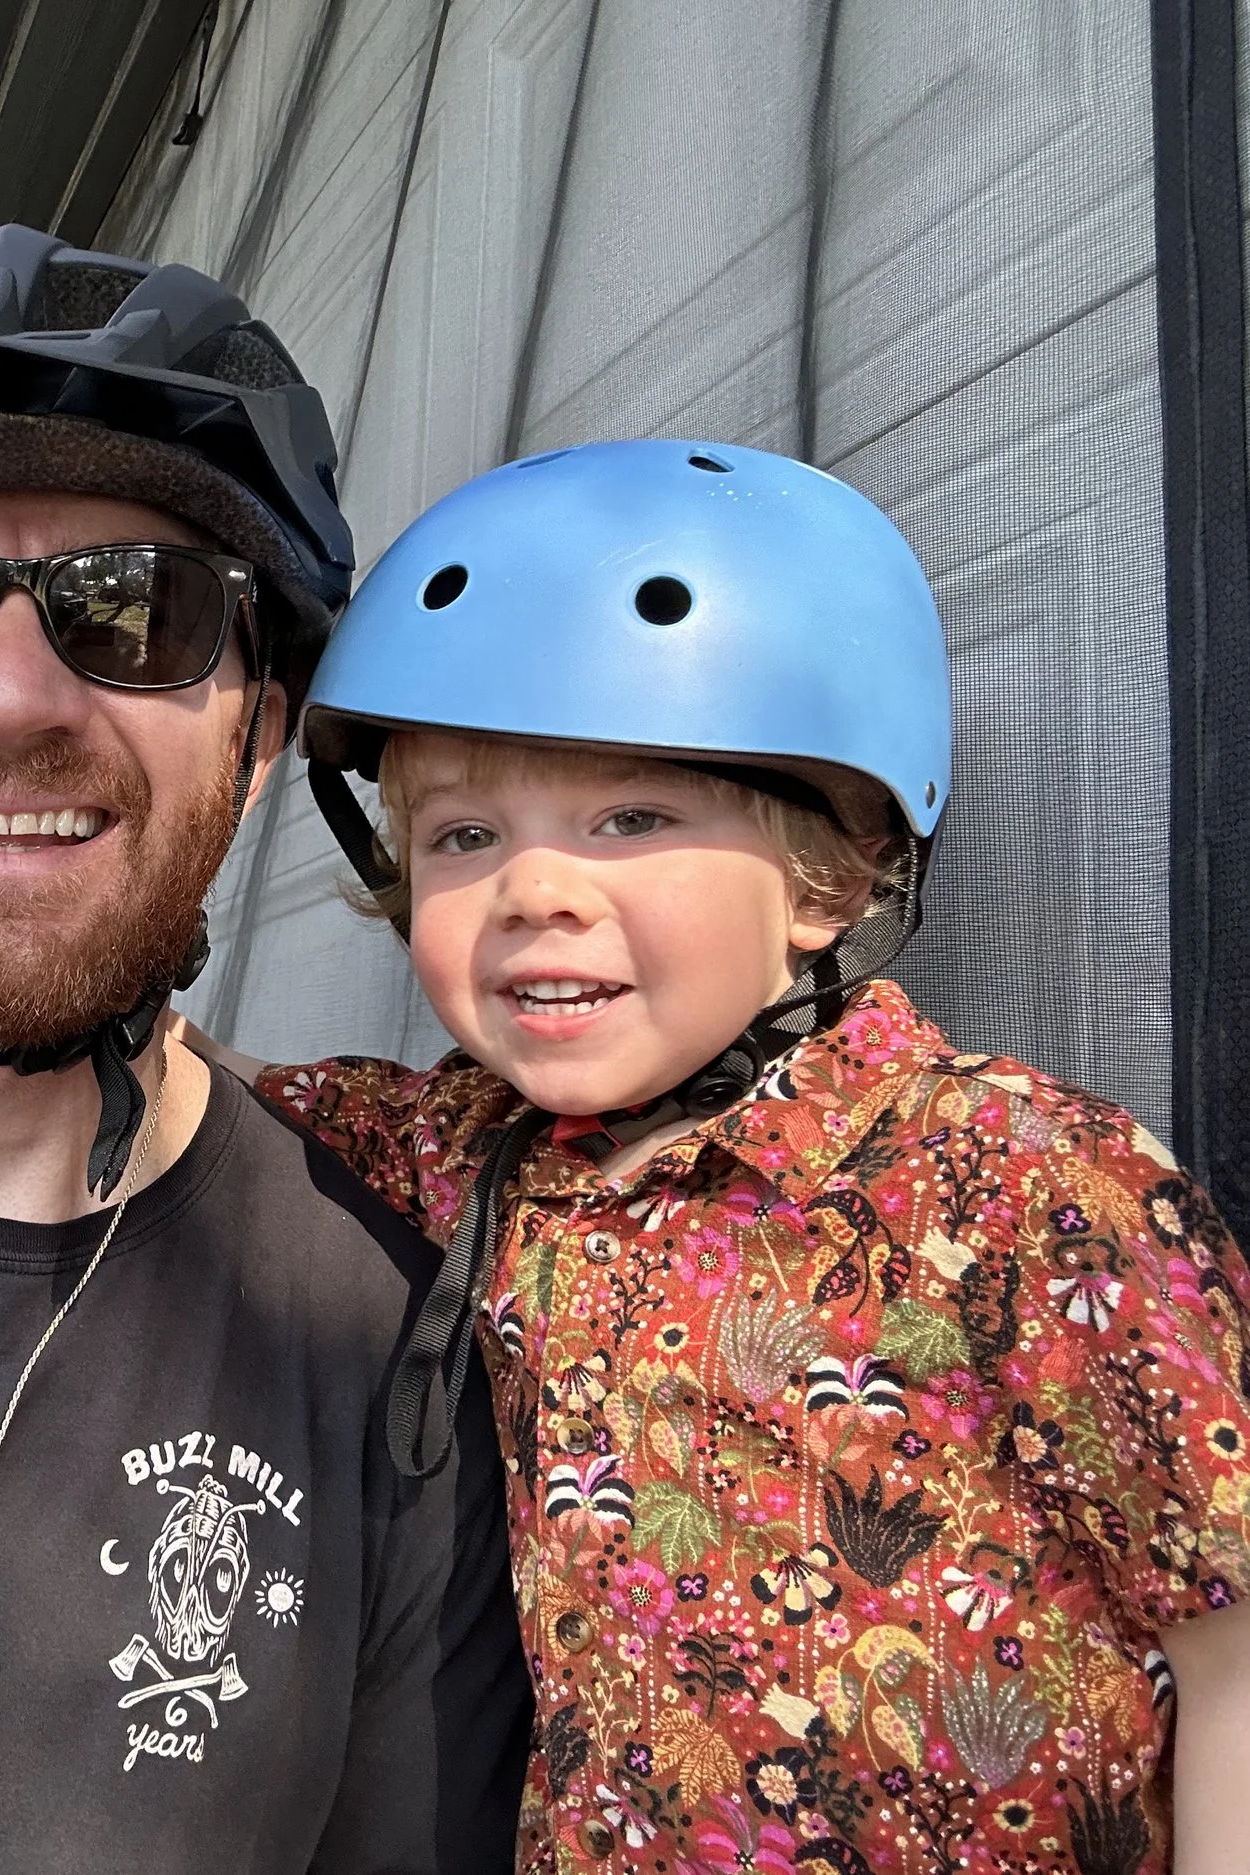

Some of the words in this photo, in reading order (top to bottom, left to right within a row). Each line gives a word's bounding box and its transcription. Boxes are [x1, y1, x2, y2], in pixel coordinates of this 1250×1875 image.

[121, 1431, 216, 1485] BUZZ
[228, 1445, 304, 1527] MILL
[165, 1696, 188, 1727] 6
[123, 1723, 204, 1772] years
